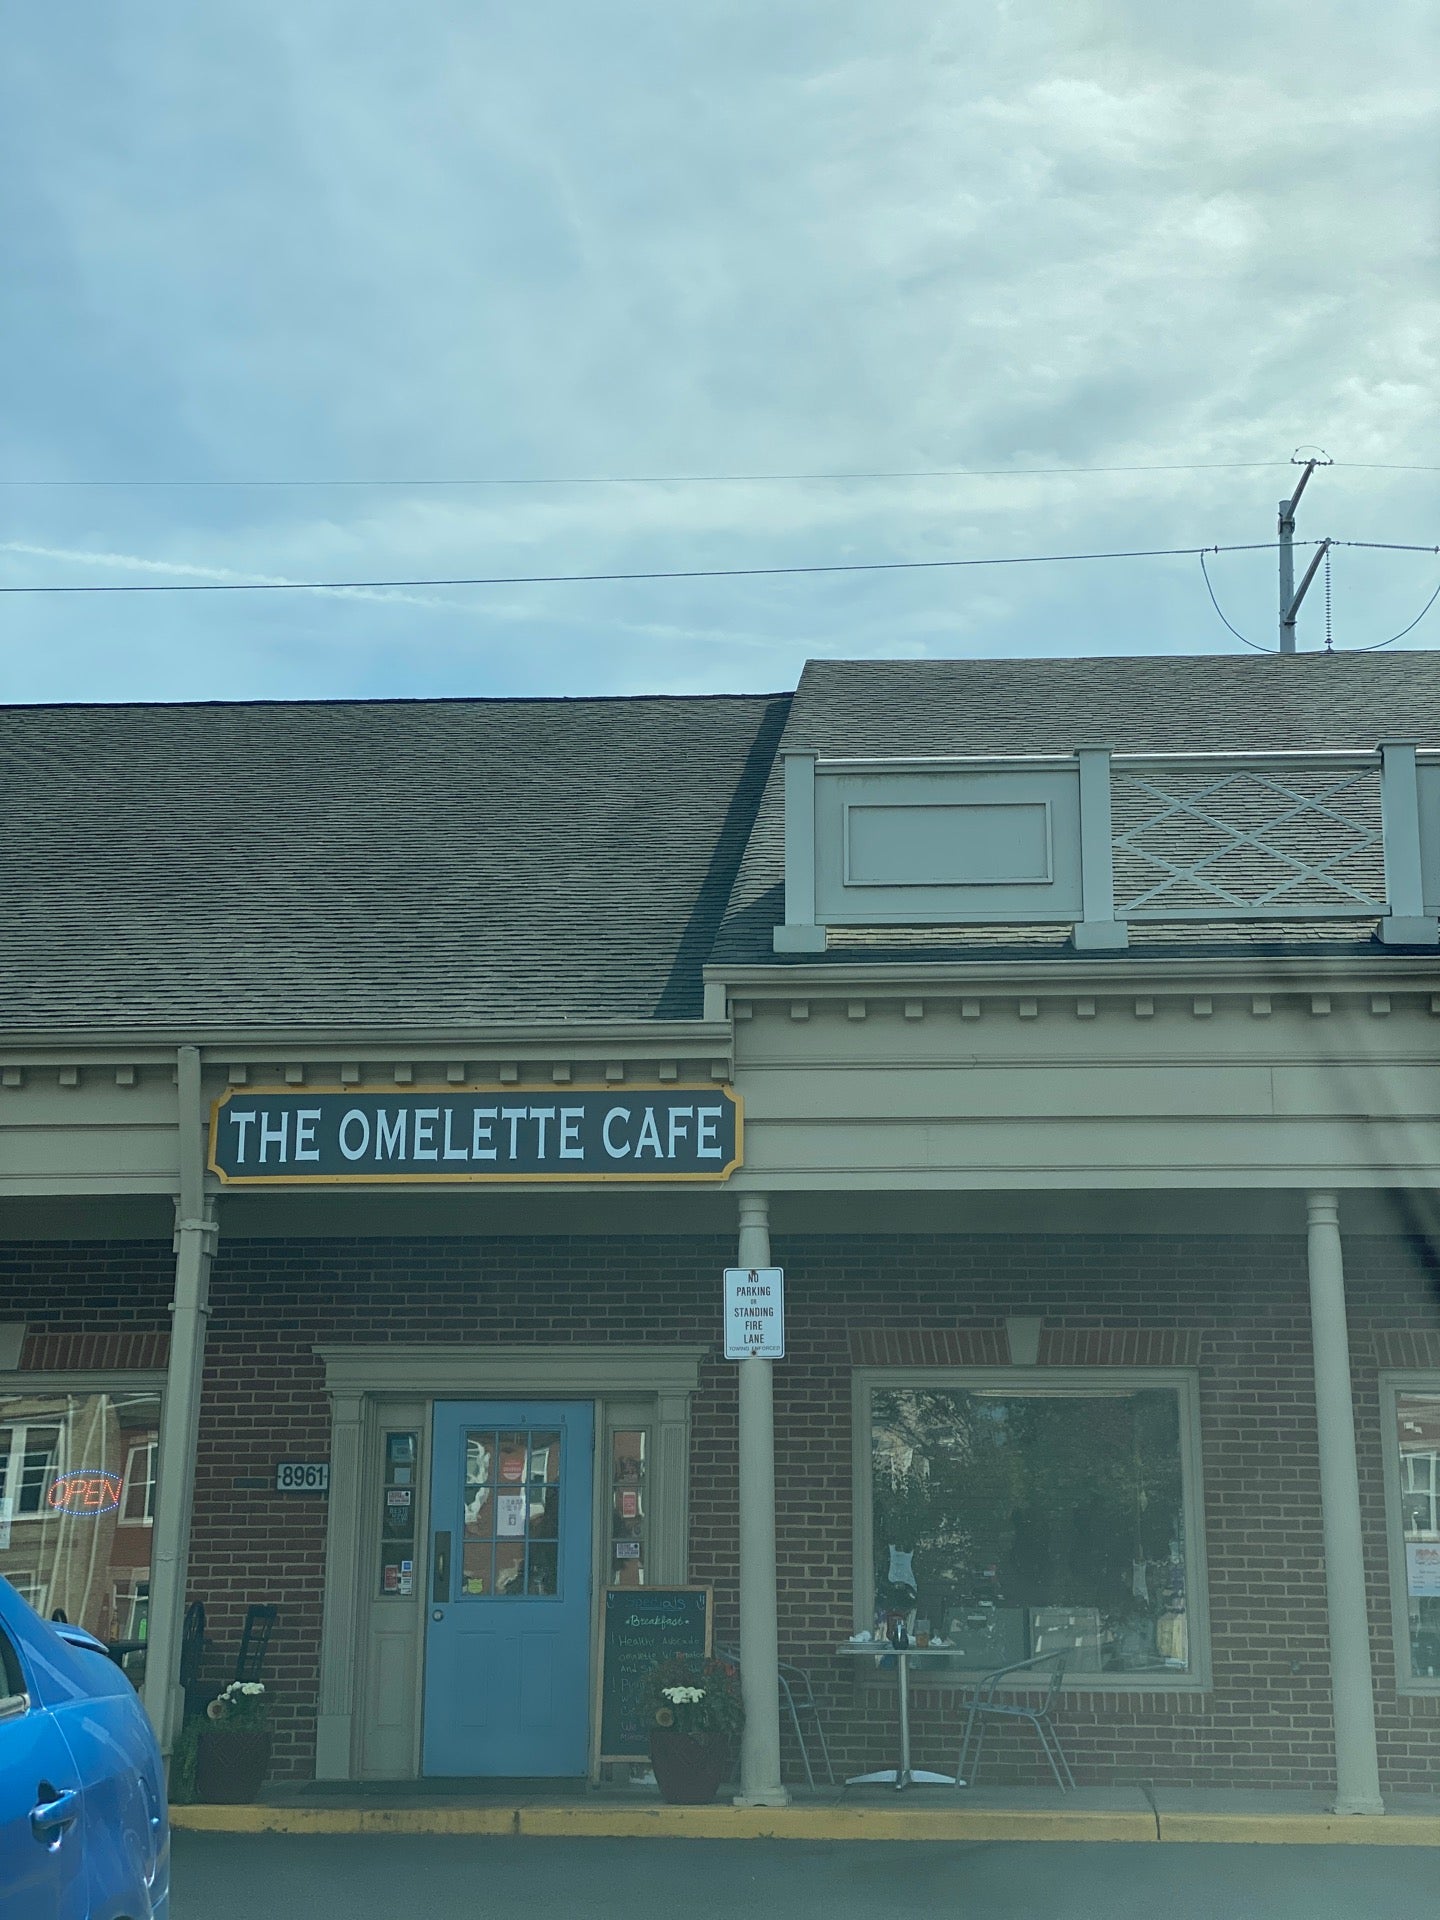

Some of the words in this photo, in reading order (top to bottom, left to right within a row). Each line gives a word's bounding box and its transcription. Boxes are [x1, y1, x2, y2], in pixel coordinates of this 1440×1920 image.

[229, 1107, 321, 1163] THE
[338, 1105, 585, 1161] OMELETTE
[603, 1105, 723, 1159] CAFE
[748, 1273, 759, 1283] NO
[736, 1287, 771, 1296] PARKING
[734, 1307, 774, 1317] STANDING
[745, 1321, 763, 1330] FIRE
[743, 1334, 765, 1344] LANE
[282, 1465, 324, 1487] 8961
[48, 1478, 124, 1507] OPEN
[631, 1614, 684, 1630] Breakfast
